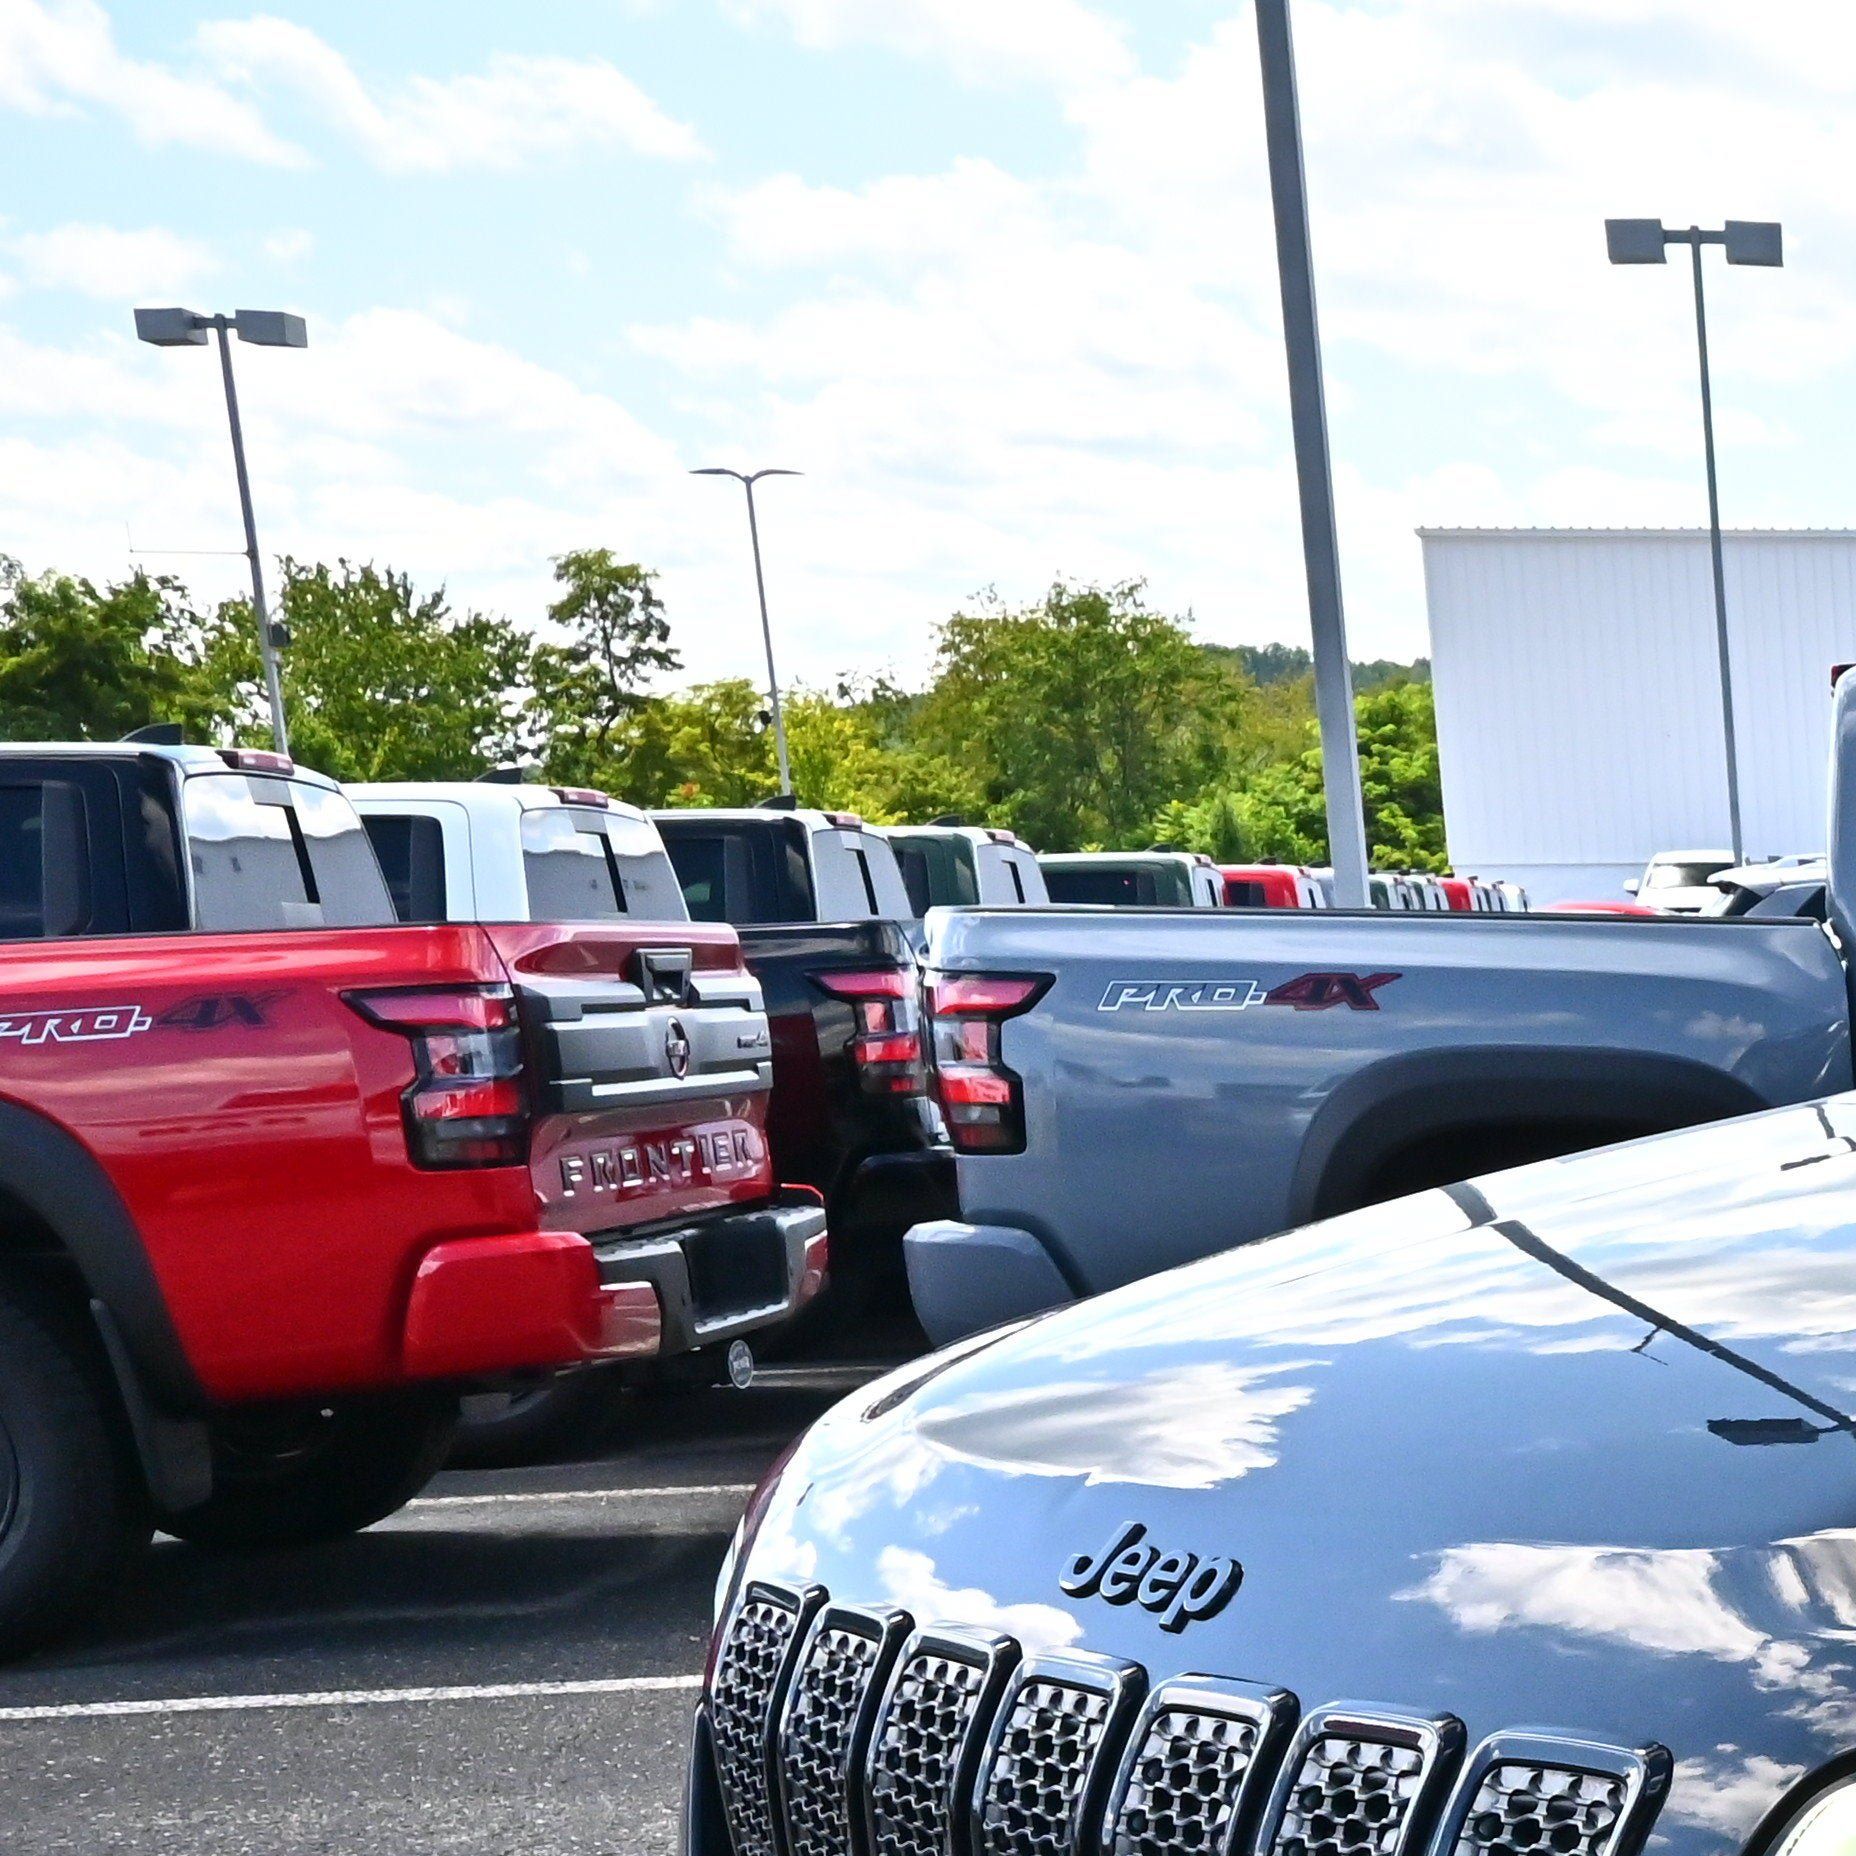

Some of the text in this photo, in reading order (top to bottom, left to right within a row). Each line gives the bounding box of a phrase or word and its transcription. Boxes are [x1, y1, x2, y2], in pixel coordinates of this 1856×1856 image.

[1097, 972, 1403, 1012] PRO-4X
[559, 1128, 756, 1197] FRONTIER
[1058, 1519, 1245, 1635] Jeep
